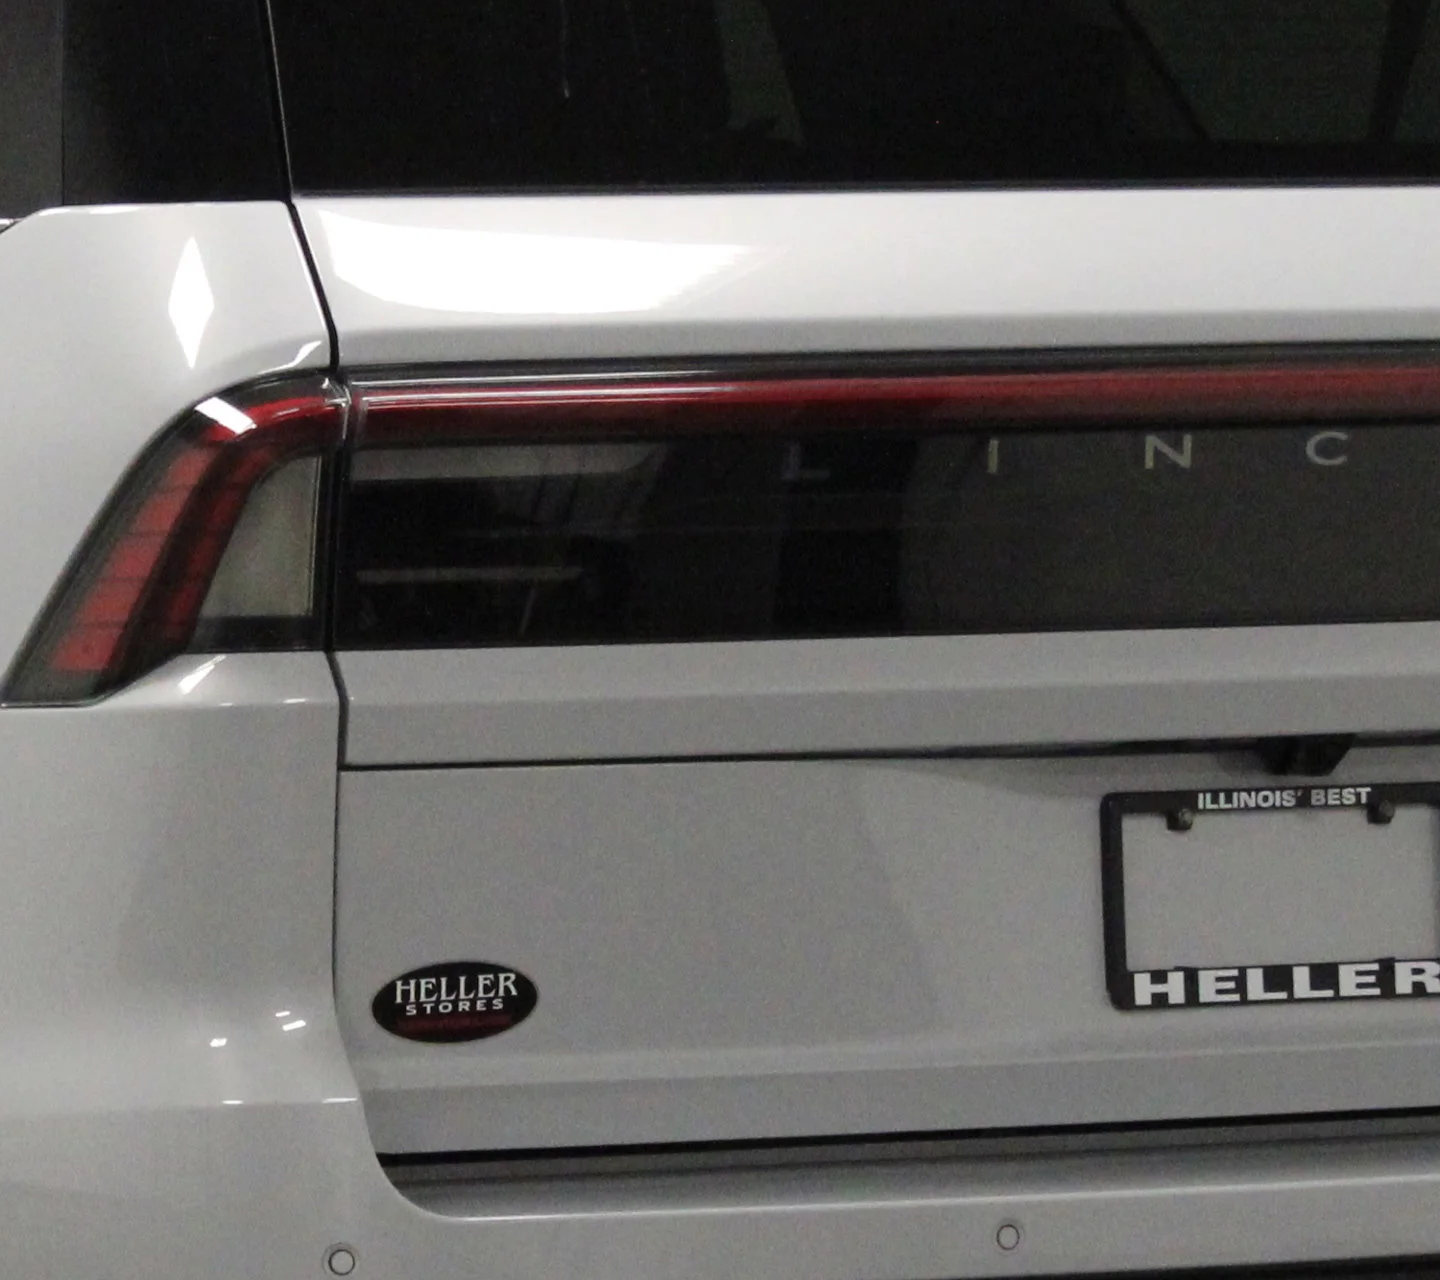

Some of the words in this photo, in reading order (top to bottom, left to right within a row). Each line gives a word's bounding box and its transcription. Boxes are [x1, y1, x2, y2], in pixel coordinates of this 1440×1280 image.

[1310, 786, 1372, 807] BEST
[395, 972, 518, 1003] HELLER
[406, 999, 504, 1016] STORES
